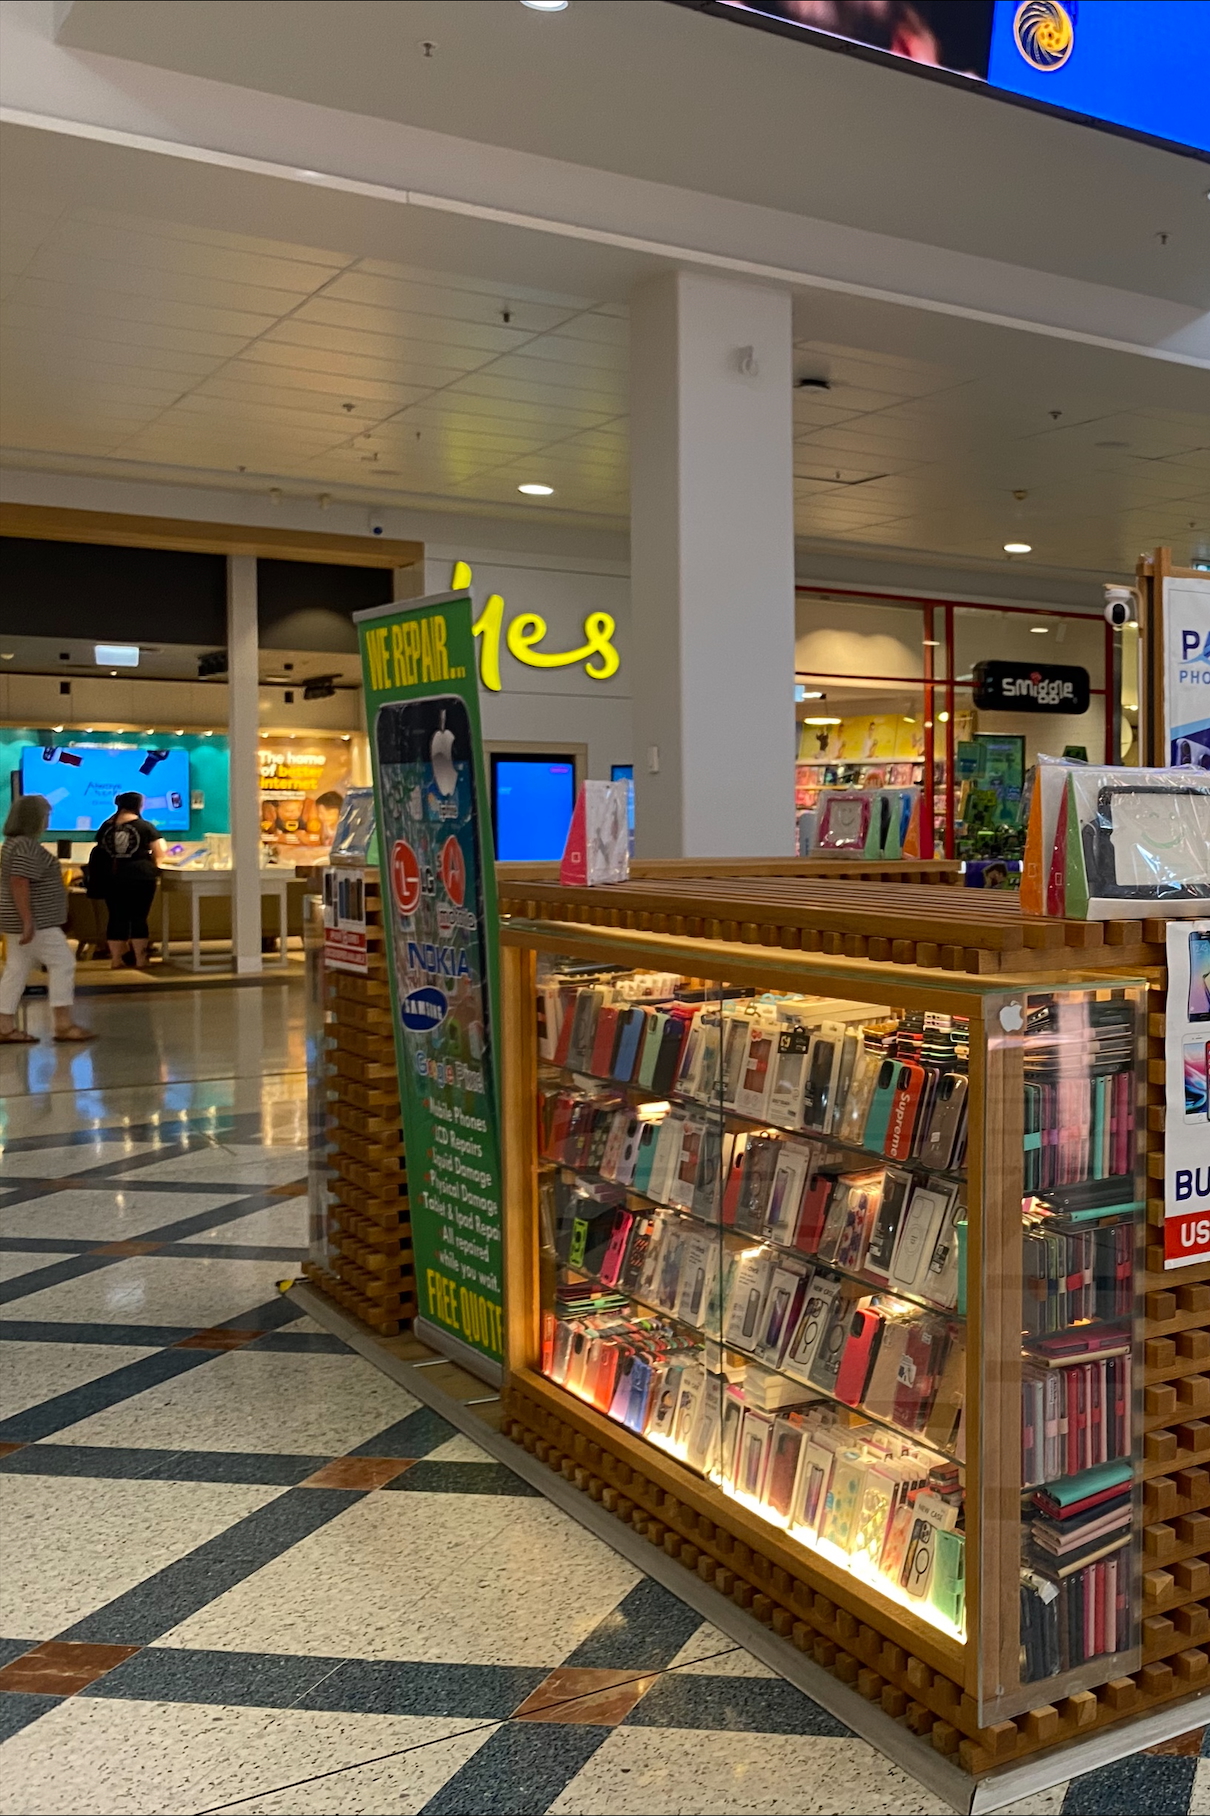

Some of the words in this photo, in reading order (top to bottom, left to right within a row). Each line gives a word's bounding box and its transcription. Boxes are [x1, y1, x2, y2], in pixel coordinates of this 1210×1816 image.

[365, 626, 392, 690] WE
[407, 940, 469, 979] NOKIA
[429, 1096, 453, 1122] Mobile
[454, 1106, 487, 1132] Phones
[890, 1092, 910, 1157] Supreme
[449, 1130, 483, 1158] Repairs
[454, 1157, 492, 1189] Damage
[423, 1191, 446, 1217] Tablet
[429, 1169, 460, 1199] Physical
[461, 1184, 498, 1217] Damage
[442, 1225, 455, 1245] All
[455, 1236, 489, 1263] repaired
[439, 1249, 460, 1272] while
[460, 1263, 477, 1280] you
[426, 1268, 459, 1329] FREE
[918, 1503, 929, 1514] NEW
